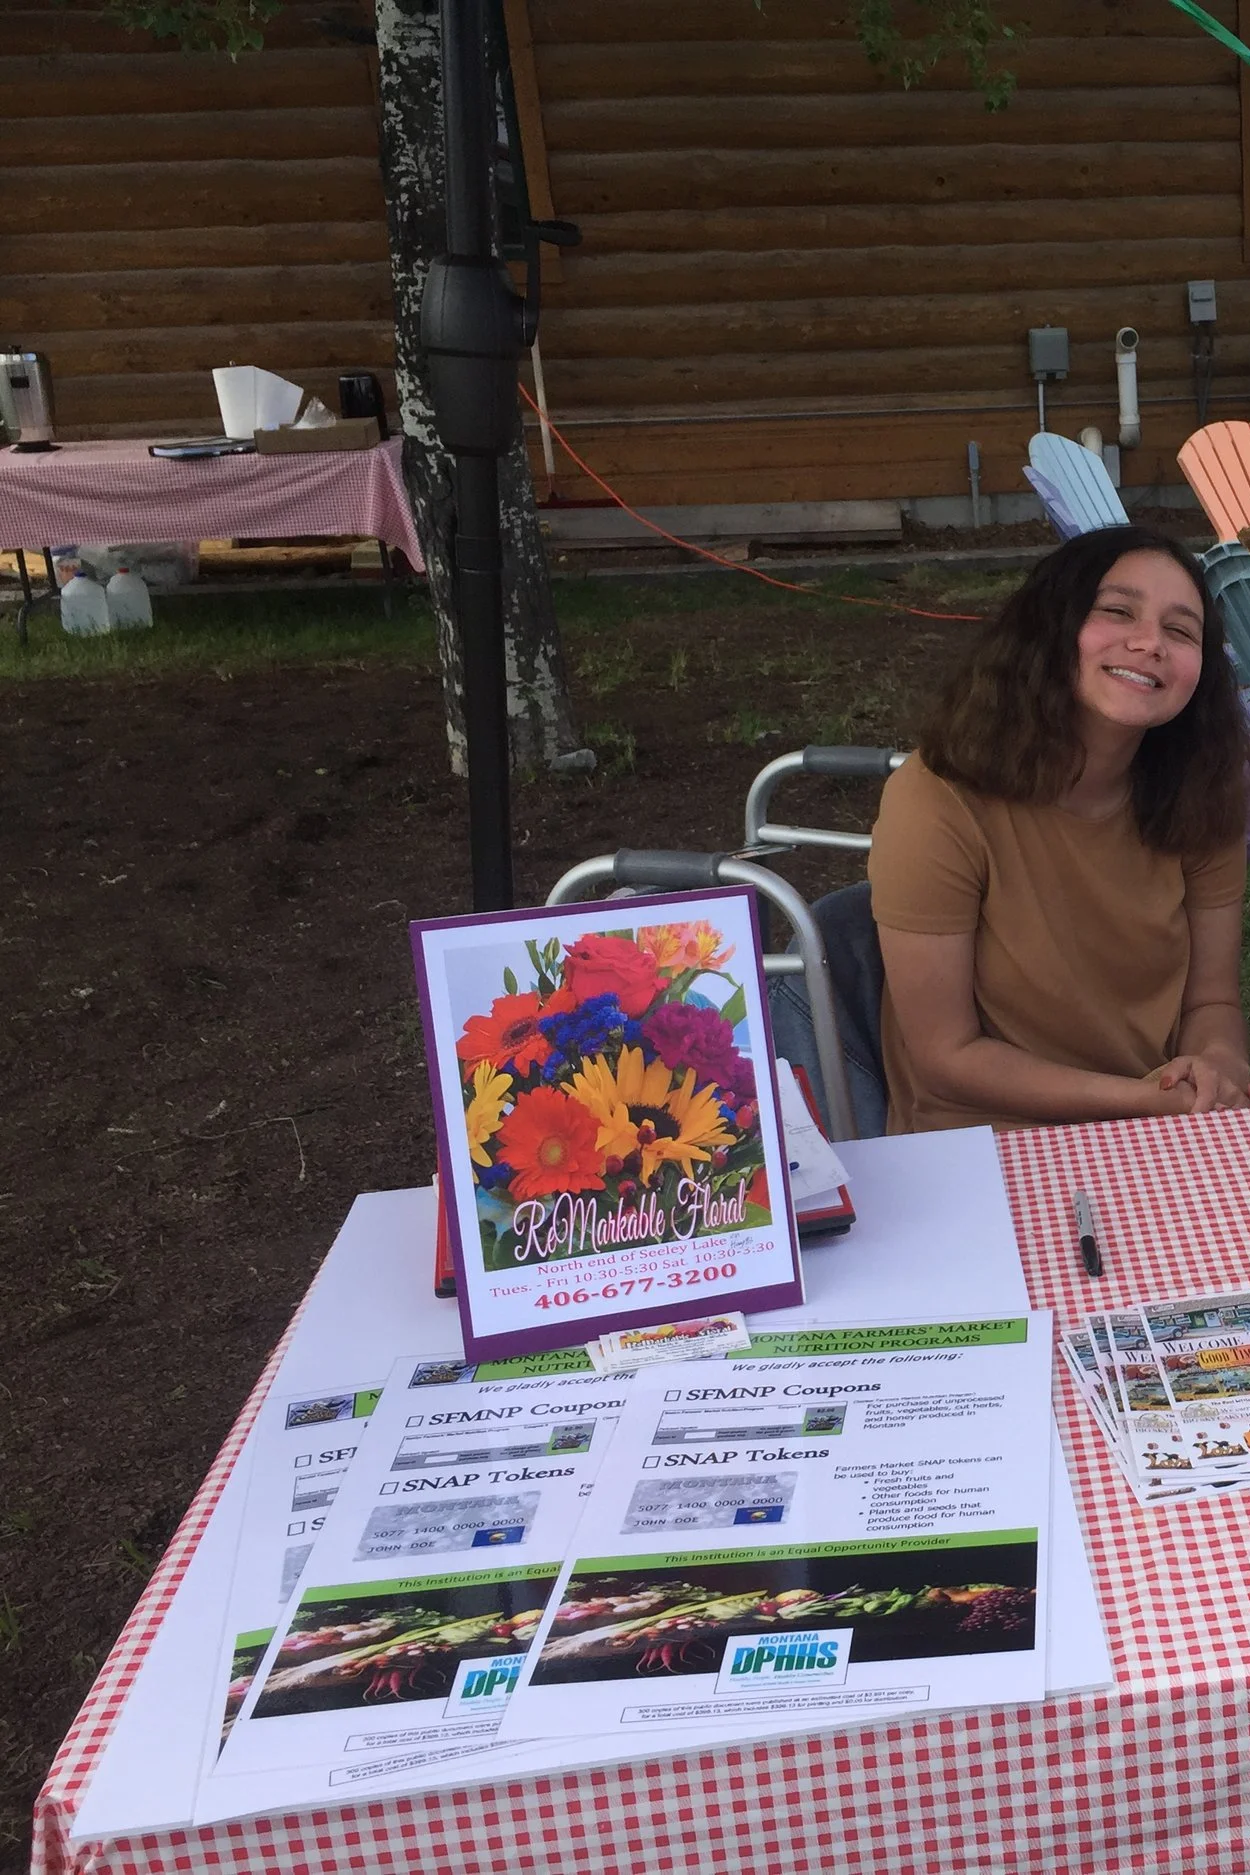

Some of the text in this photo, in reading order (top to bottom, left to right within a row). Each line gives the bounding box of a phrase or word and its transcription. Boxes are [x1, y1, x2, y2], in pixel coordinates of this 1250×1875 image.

[513, 1178, 746, 1261] ReMarkable Floral
[538, 1236, 728, 1275] North end of Seeley Lake
[489, 1286, 532, 1298] Tues.
[546, 1277, 569, 1288] Fri
[575, 1261, 658, 1282] 10:30-5:30
[662, 1256, 688, 1270] Sat.
[534, 1263, 738, 1309] 406-677-3200
[751, 1321, 1015, 1344] MONTANA FARMERS' MARKET
[773, 1334, 981, 1354] NUTRITION PROGRAMS
[1162, 1336, 1245, 1353] WELCOME
[732, 1352, 964, 1372] We gladly accept the following:
[1199, 1351, 1230, 1364] GOOD
[686, 1381, 881, 1402] SFMNP Coupons
[664, 1448, 830, 1467] SNAP Tokens
[836, 1464, 877, 1472] Farmers
[949, 1456, 982, 1464] tokens
[659, 1475, 778, 1490] MONTANA
[638, 1504, 668, 1512] 5077
[715, 1499, 745, 1507] 0000
[752, 1497, 783, 1505] 0000
[634, 1519, 666, 1527] JOHN
[664, 1537, 951, 1564] This Institution is an Equal Opportunity Provider
[758, 1632, 819, 1645] MONTANA
[730, 1641, 839, 1675] DPHHS
